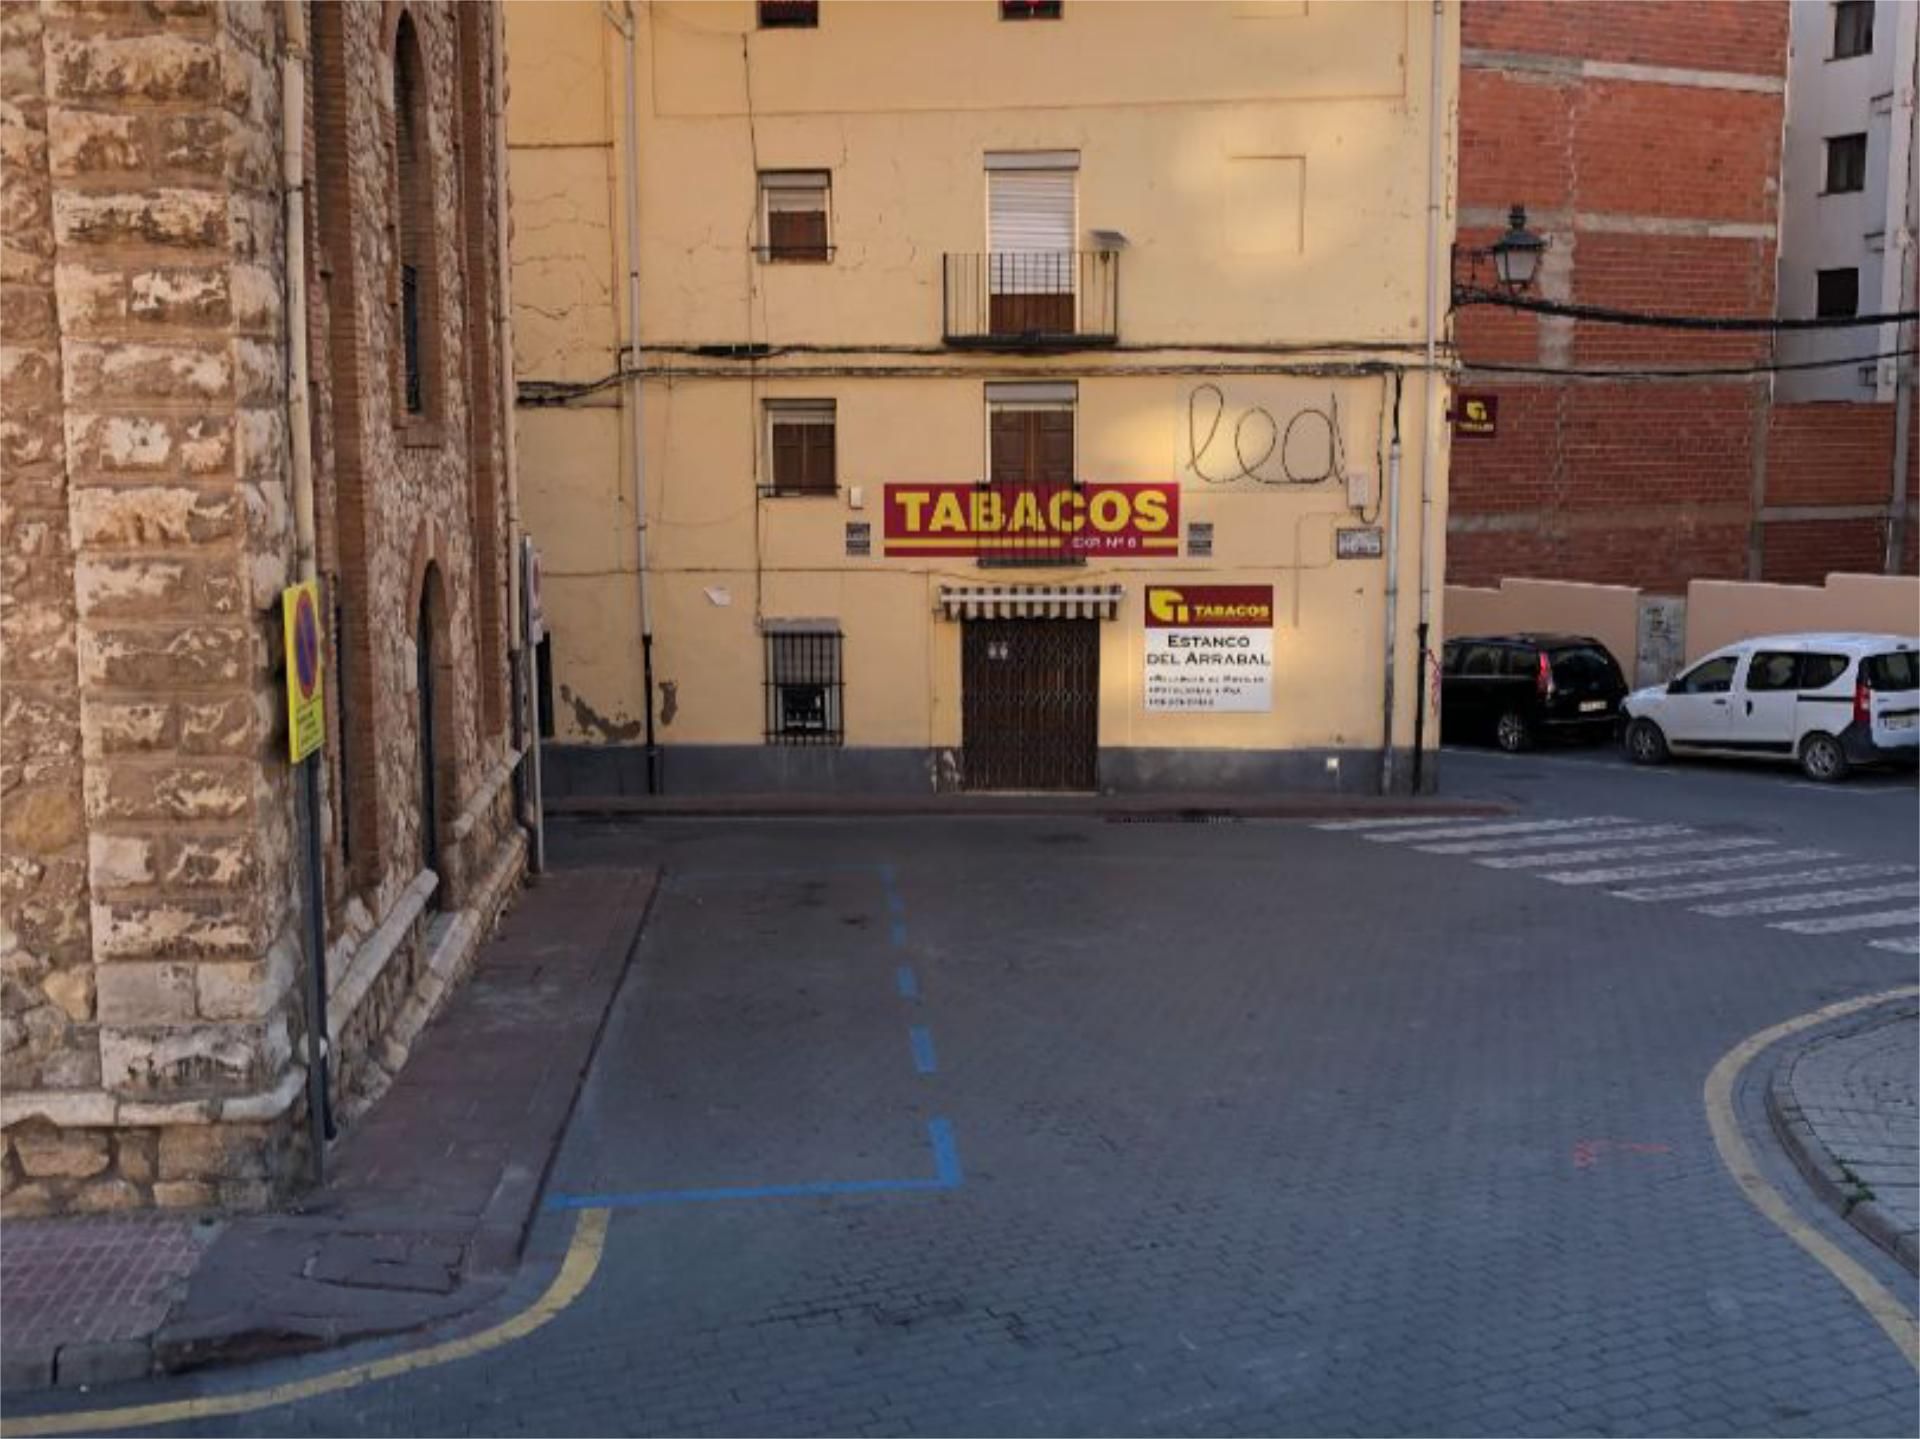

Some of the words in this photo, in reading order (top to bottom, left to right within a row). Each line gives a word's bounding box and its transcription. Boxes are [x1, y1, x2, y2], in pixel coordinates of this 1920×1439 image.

[896, 490, 1169, 532] TABACOS
[1195, 604, 1269, 617] TABACOS
[1167, 634, 1250, 648] ESTANCO
[1147, 652, 1180, 665] DEL
[1184, 651, 1271, 665] ARRABAL
